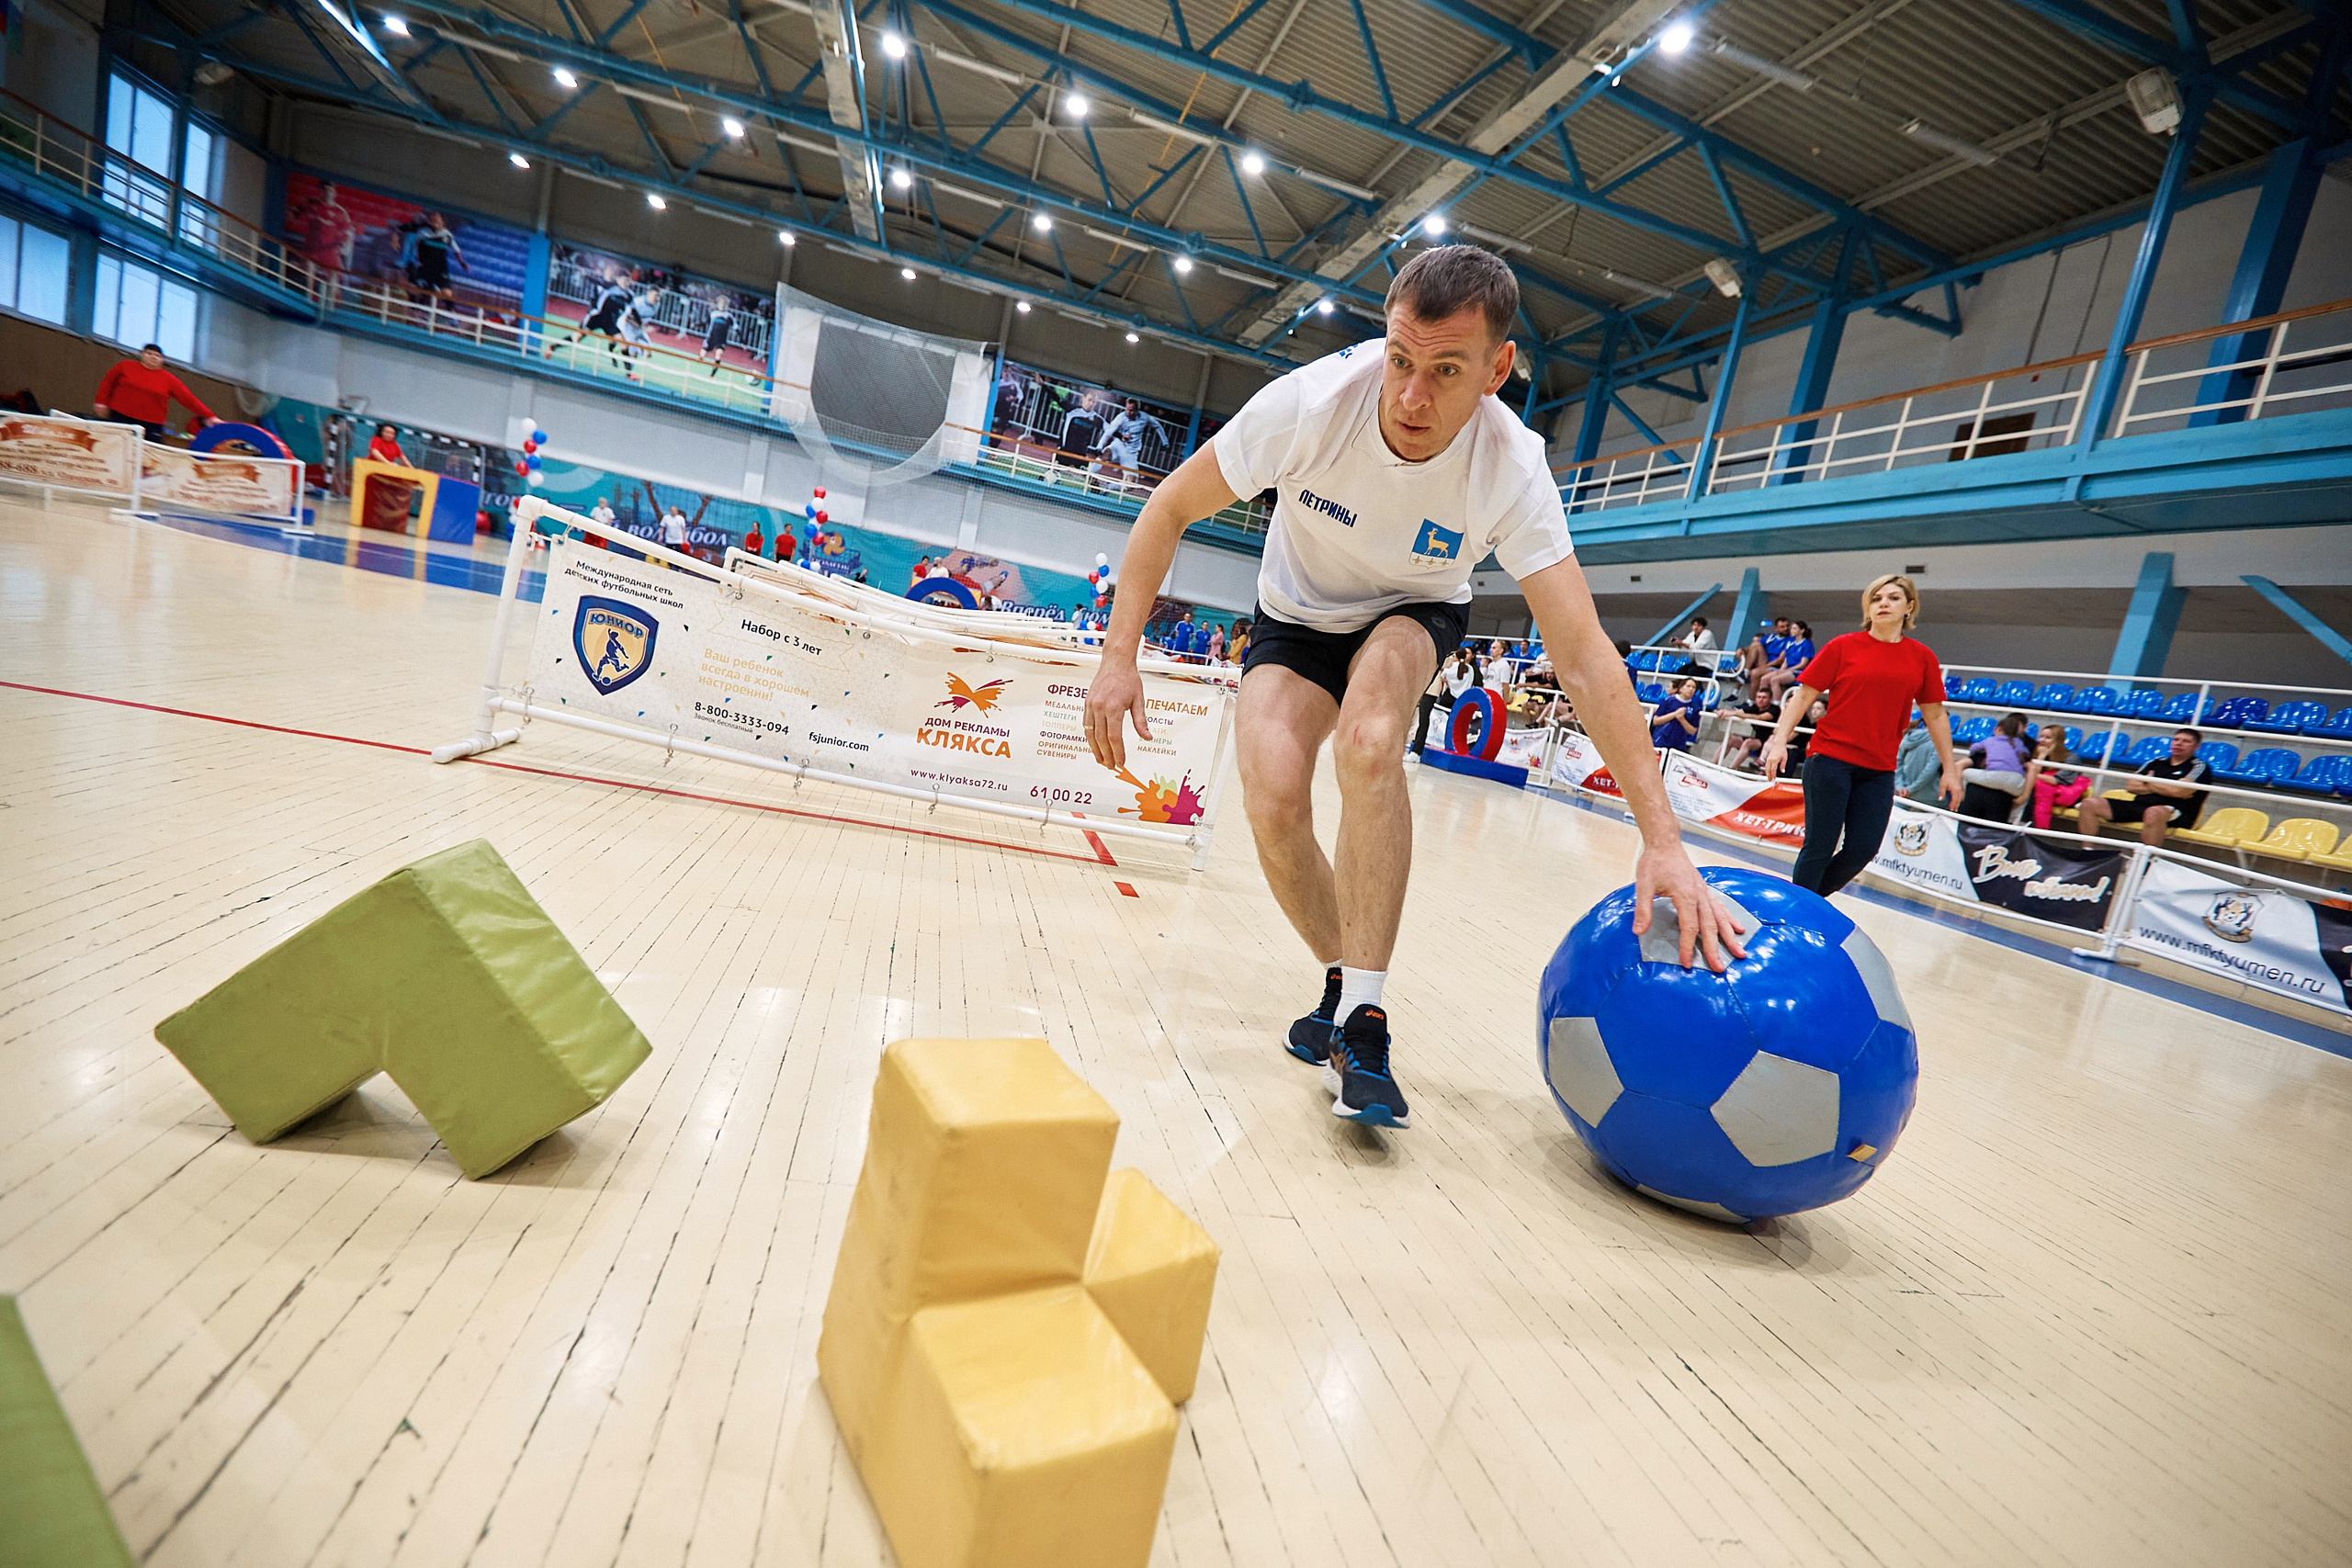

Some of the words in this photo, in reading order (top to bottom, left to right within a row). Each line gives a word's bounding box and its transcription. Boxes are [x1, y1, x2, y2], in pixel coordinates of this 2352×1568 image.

[1298, 489, 1358, 528] ПЕТРИНЫ
[564, 567, 599, 585] детских
[601, 580, 658, 602] футбольных
[660, 598, 684, 610] школ
[576, 560, 651, 590] Международная
[654, 584, 673, 596] сеть
[589, 612, 644, 639] ЮНИОР
[741, 618, 781, 642] Набор
[784, 635, 790, 644] с
[793, 636, 800, 648] 3
[801, 643, 822, 656] лет
[704, 648, 729, 664] Ваш
[732, 656, 784, 678] ребенок
[698, 675, 774, 702] настроении!
[701, 662, 741, 682] всегда
[745, 674, 751, 682] в
[754, 676, 810, 698] хорошем
[1047, 684, 1089, 699] ФРЕЗЕ
[1043, 710, 1077, 721] ХЕШТЕГИ
[1145, 698, 1208, 716] ПЕЧАТАЕМ
[694, 702, 790, 736] 8-800-3333-094
[694, 712, 717, 725] Звонок
[717, 718, 753, 734] бесплатный
[924, 716, 952, 728] ДОМ
[954, 721, 1011, 738] РЕКЛАМЫ
[1042, 720, 1077, 731] ТОППЕРЫ
[1147, 716, 1173, 726] ОЛСТЫ
[808, 731, 870, 752] fsjunior.com
[916, 728, 1012, 759] КЛЯКСА
[1039, 730, 1088, 743] ФОТОРАМКИ
[1036, 749, 1077, 760] СУВЕНИРЫ
[1136, 745, 1177, 756] НАКЛЕЙКИ
[910, 768, 1009, 792] www.klyaksa72.ru
[1029, 785, 1047, 799] 61
[1052, 788, 1070, 802] 00
[1074, 791, 1092, 805] 22
[2139, 926, 2325, 994] www.mfktyumen.ru
